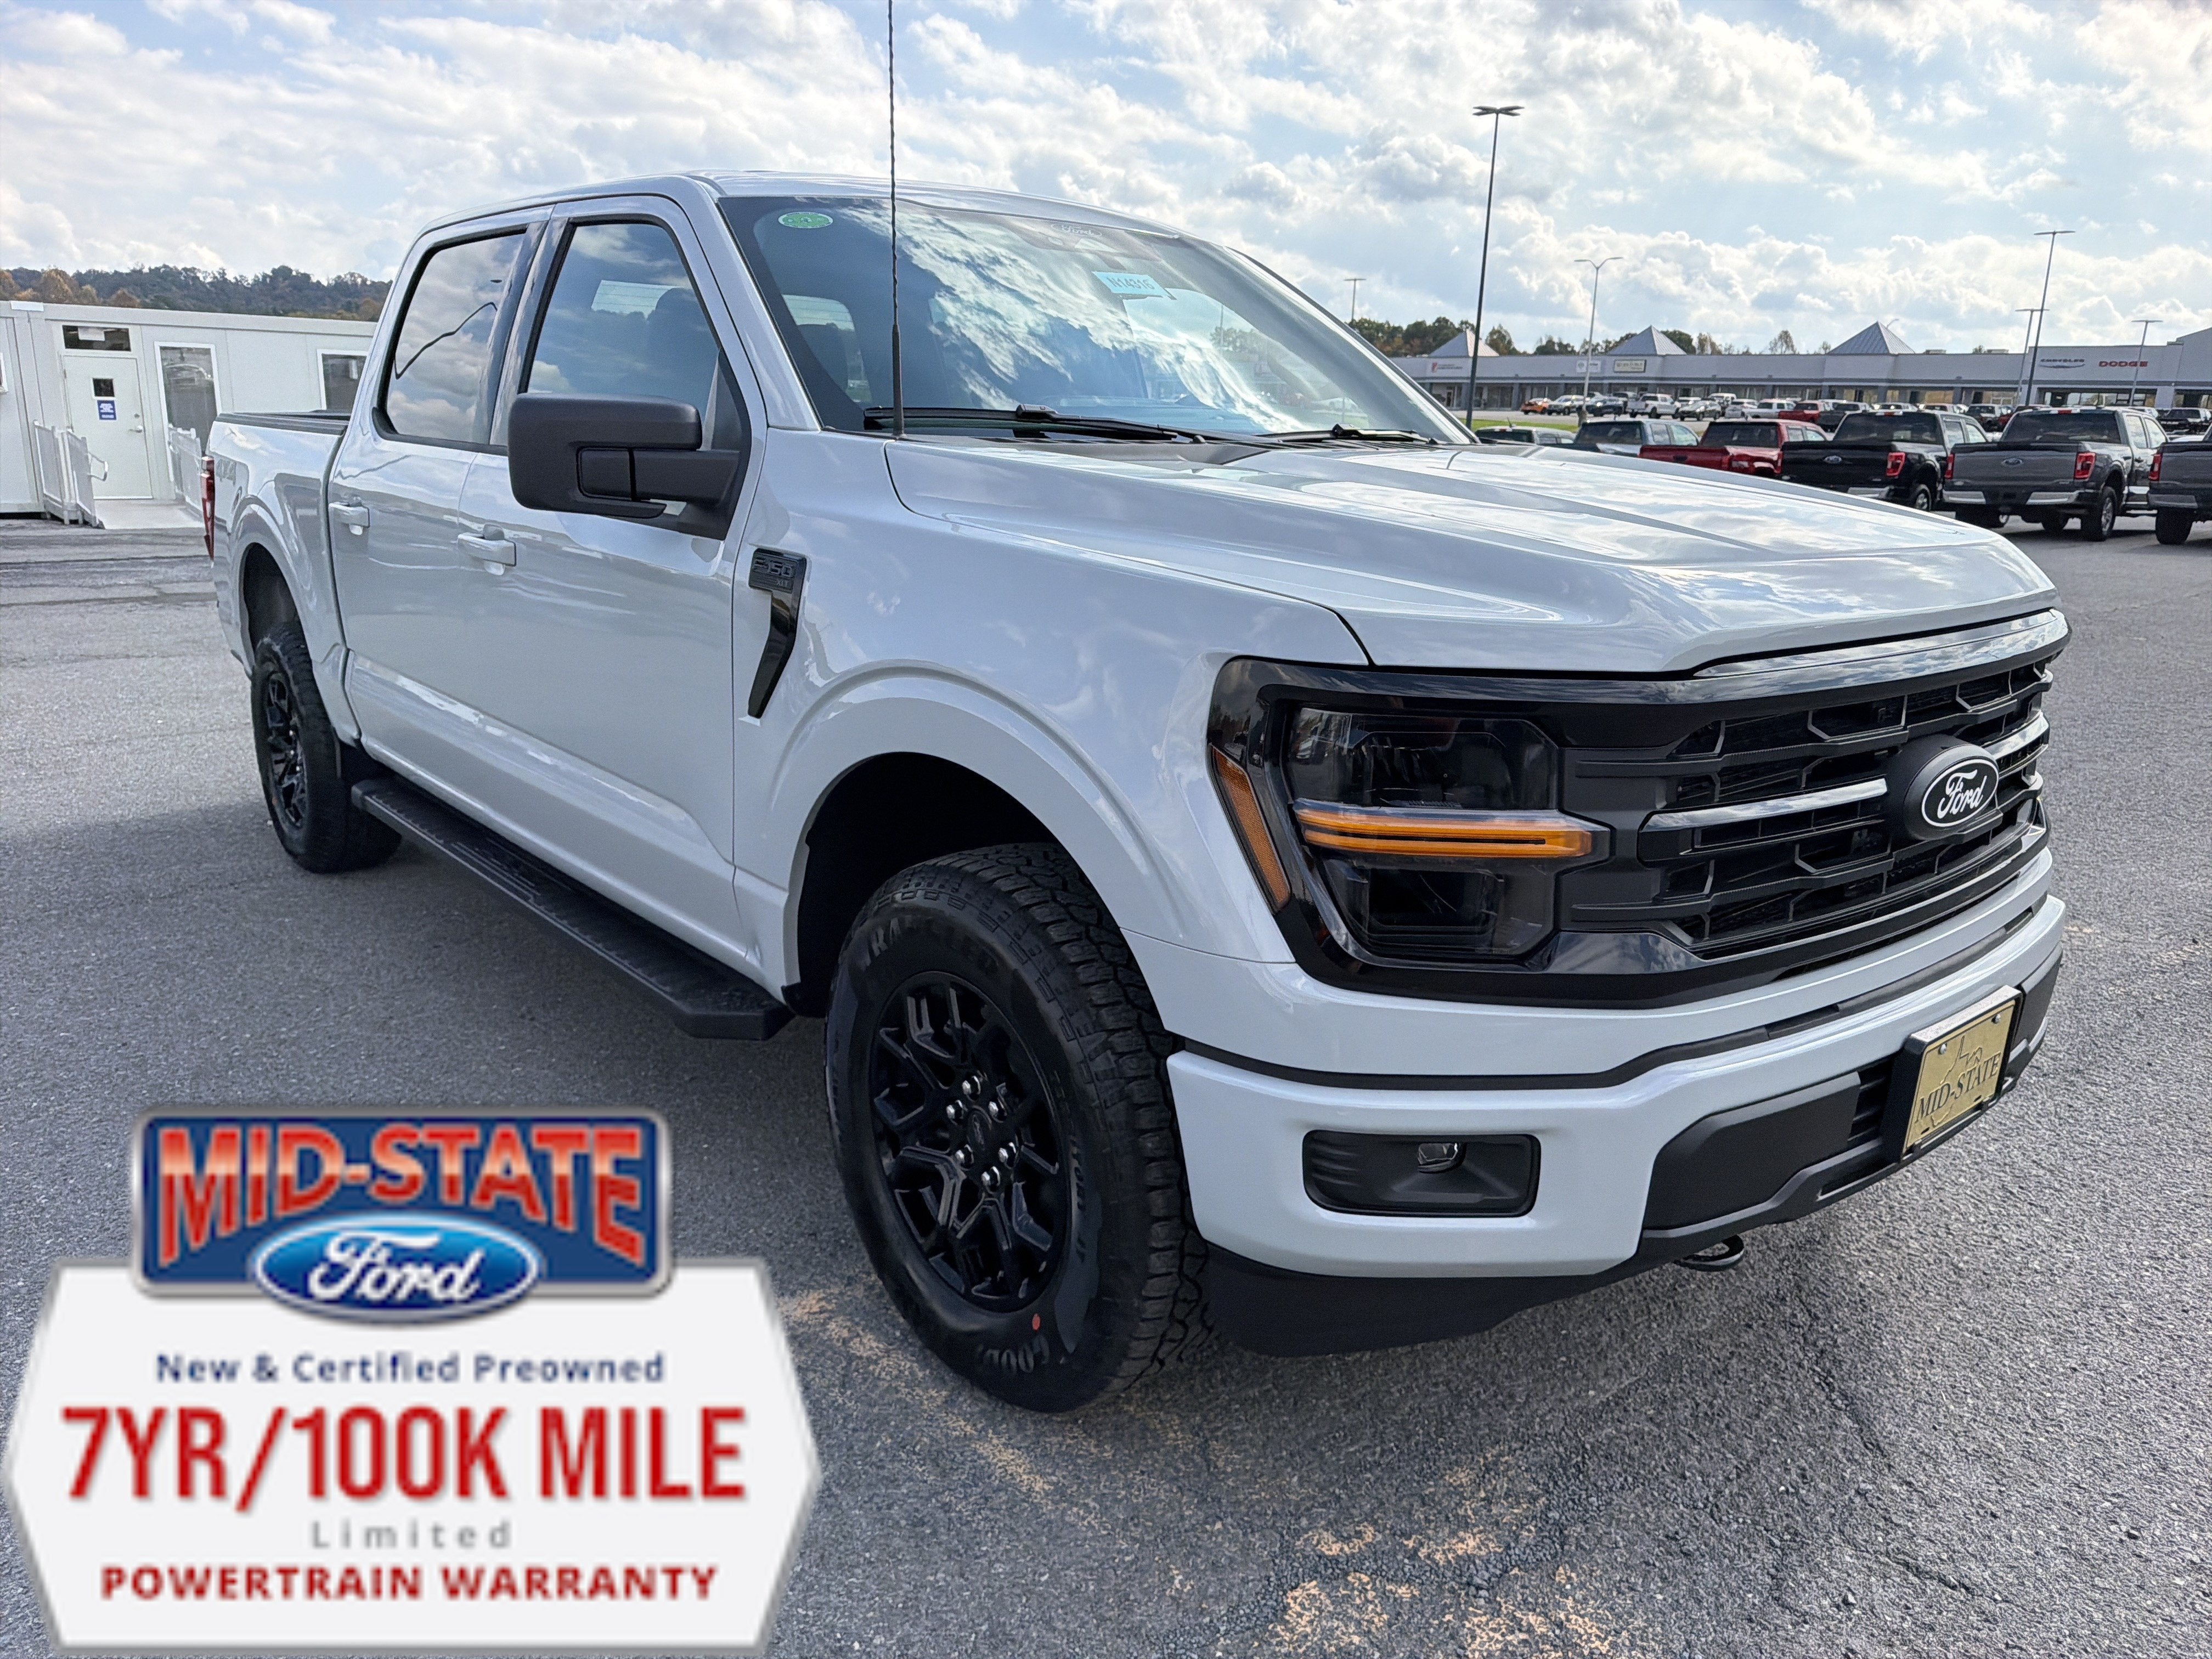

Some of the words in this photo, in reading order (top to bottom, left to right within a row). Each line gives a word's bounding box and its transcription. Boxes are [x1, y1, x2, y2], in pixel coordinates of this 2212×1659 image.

[1106, 277, 1155, 290] N14316
[1937, 769, 1987, 819] Ford
[1915, 1051, 2001, 1124] MID-STATE
